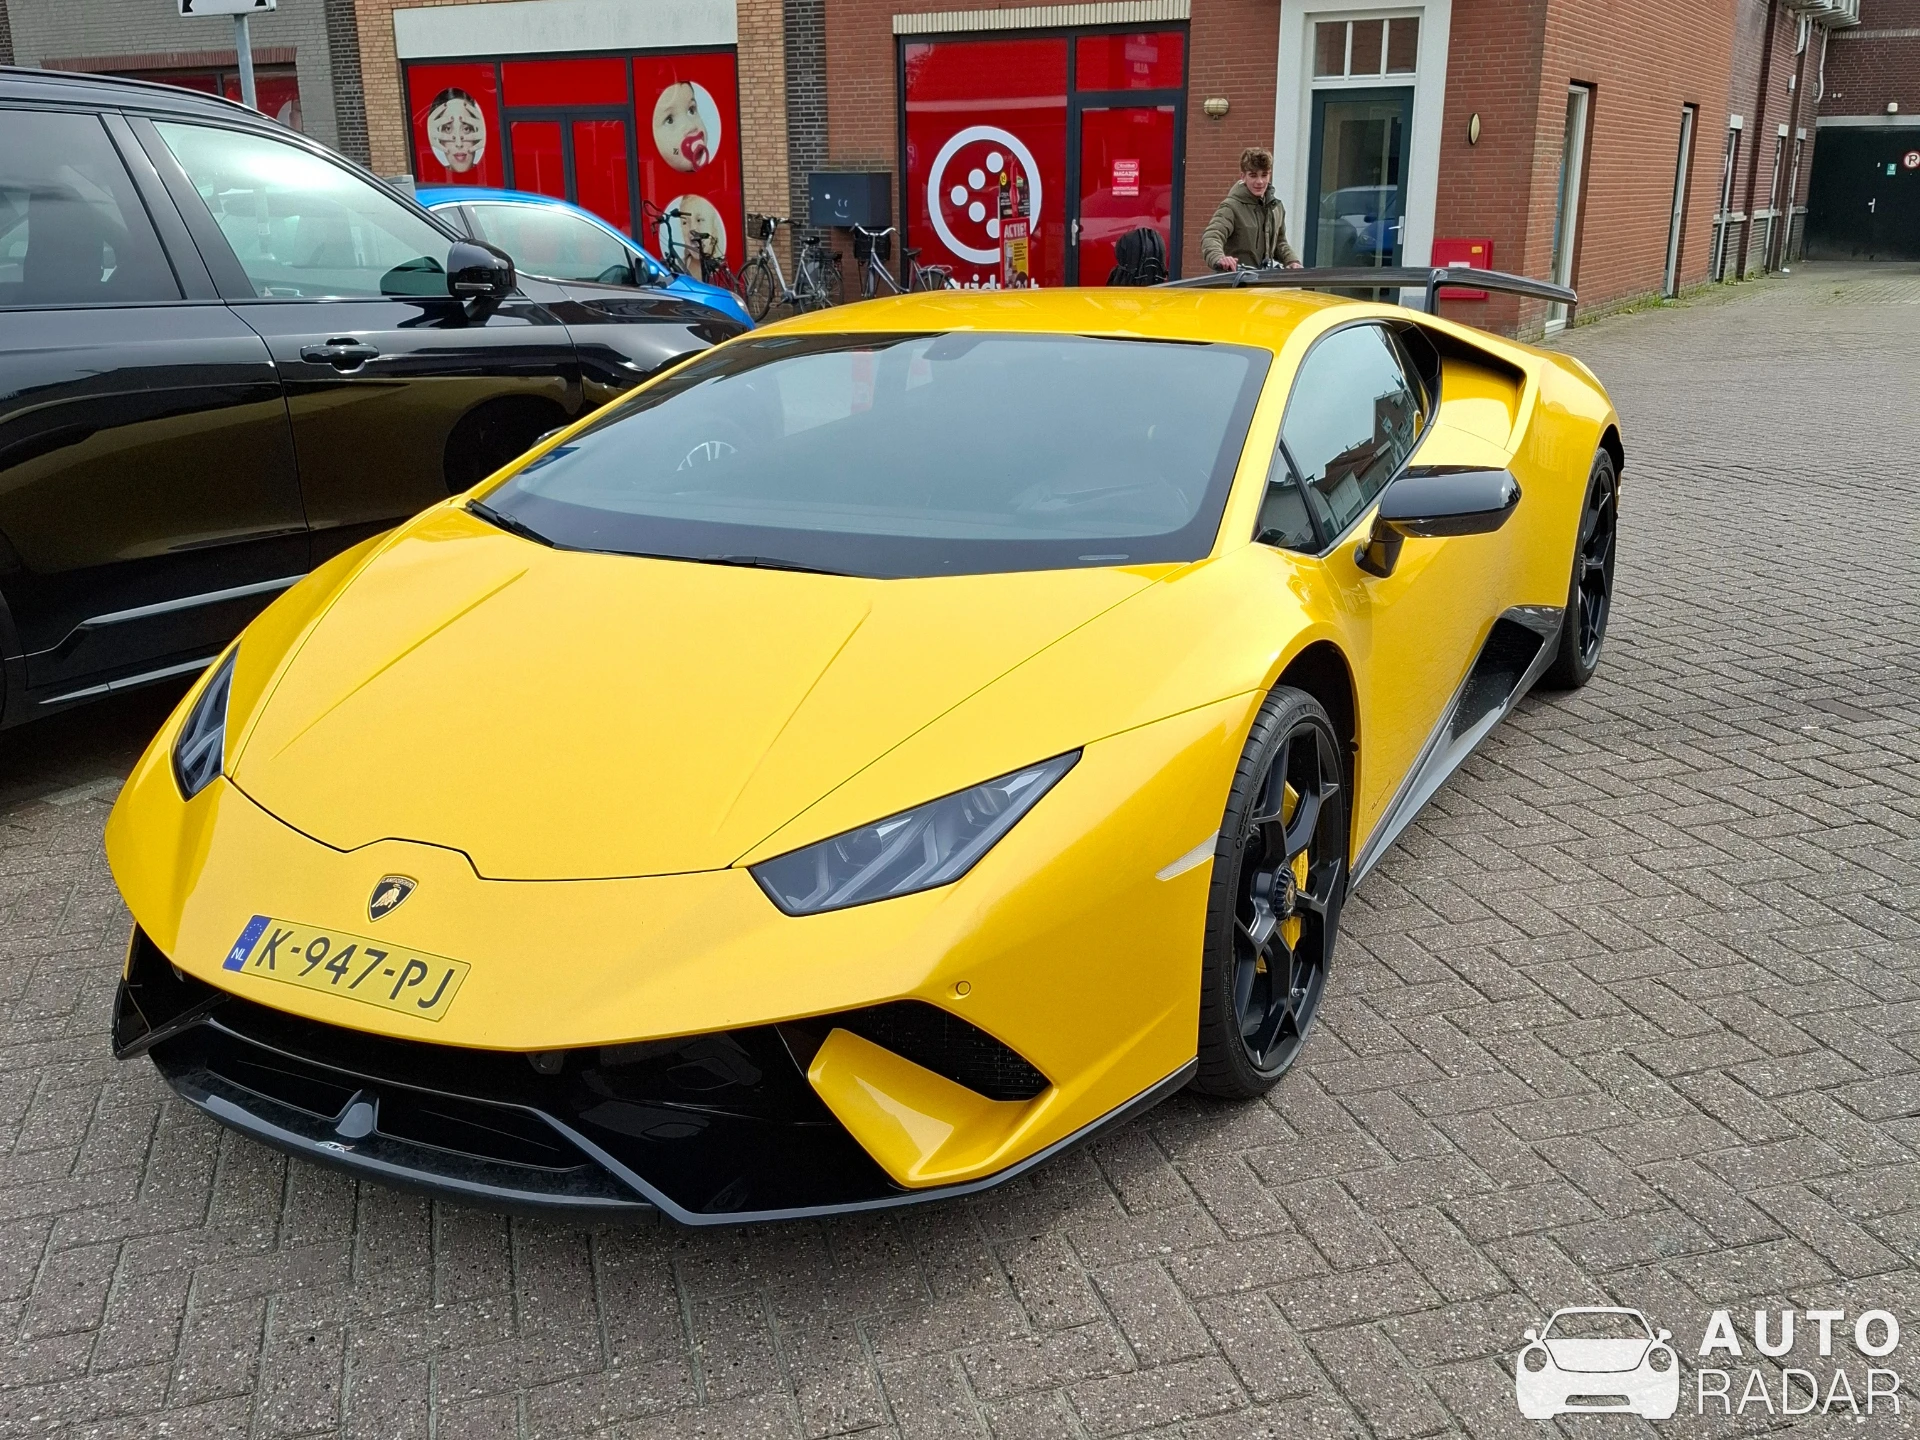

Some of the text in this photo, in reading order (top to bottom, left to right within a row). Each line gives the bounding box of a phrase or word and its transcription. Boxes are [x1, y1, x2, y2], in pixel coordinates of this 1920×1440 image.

[1004, 222, 1027, 238] ACTIE!
[231, 947, 246, 962] NL
[254, 927, 455, 1009] K-947-PJ
